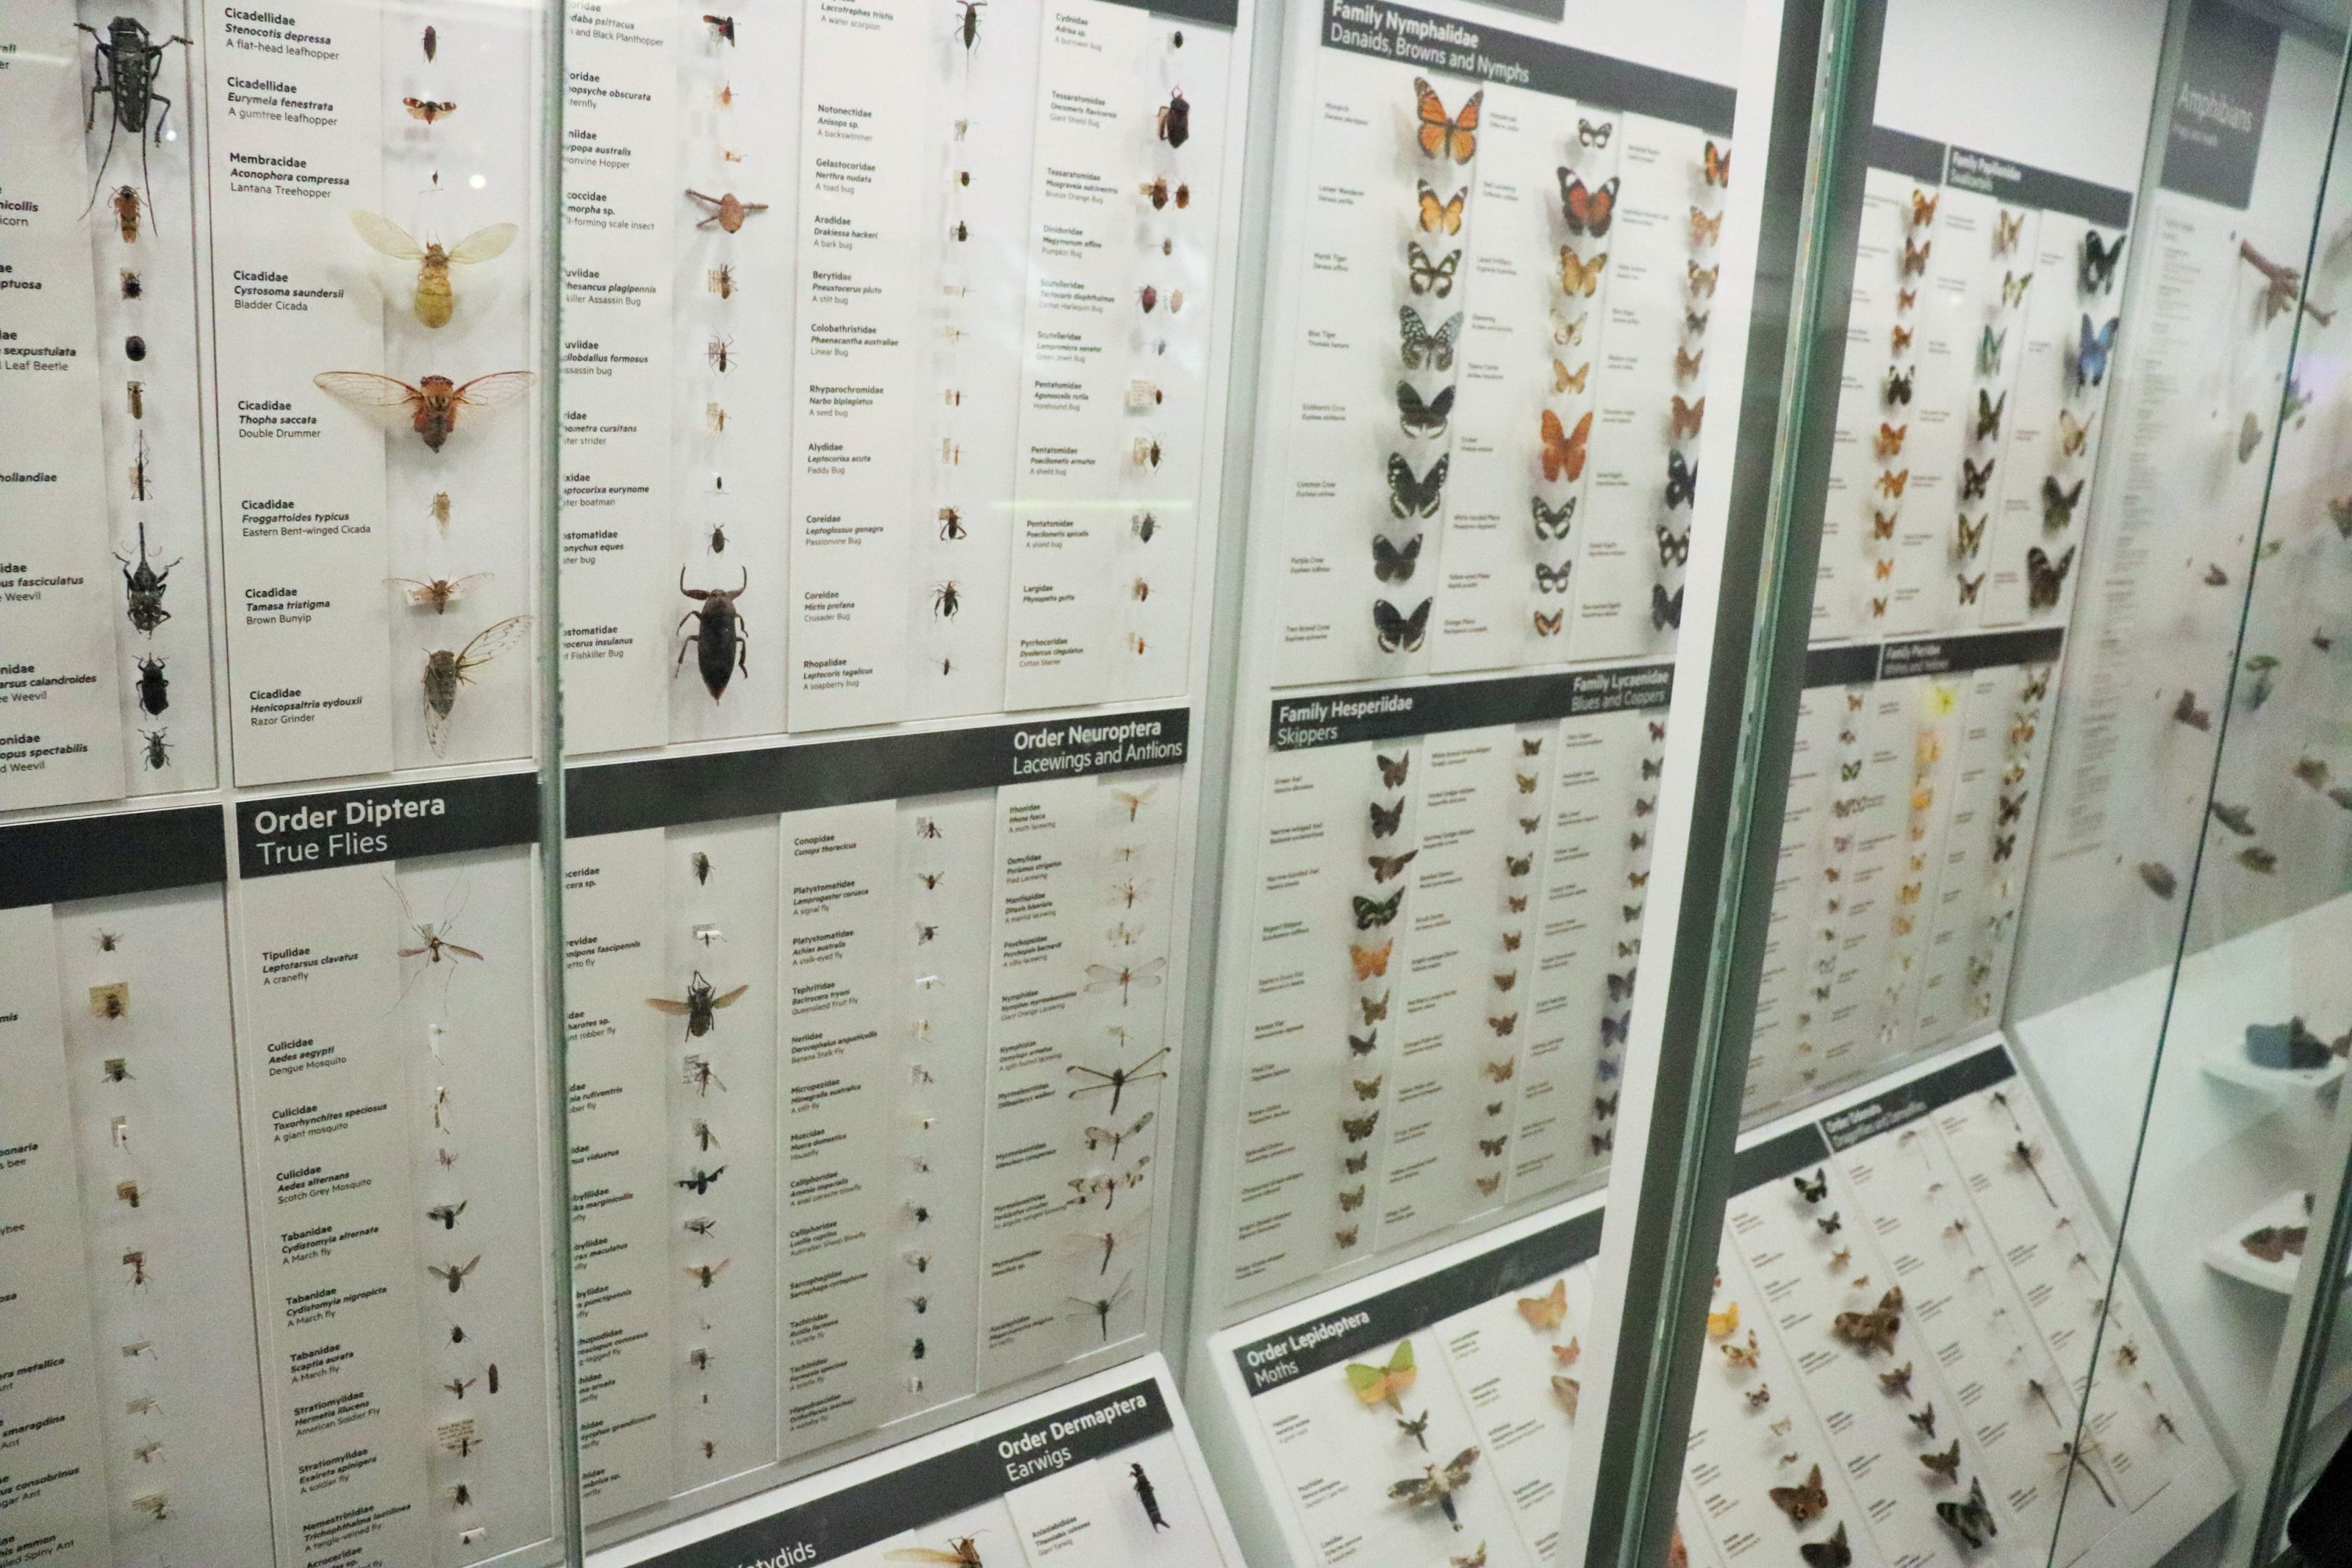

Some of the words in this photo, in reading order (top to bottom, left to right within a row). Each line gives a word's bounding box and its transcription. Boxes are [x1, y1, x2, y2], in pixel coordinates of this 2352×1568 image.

[225, 8, 295, 25] Cicadellidae
[1332, 1, 1382, 28] Family
[1387, 11, 1479, 48] Nymphalidae
[226, 24, 281, 38] Stenocotis
[285, 31, 331, 45] depressa
[593, 30, 614, 40] Black
[616, 33, 663, 46] Planthopper
[226, 39, 234, 48] A
[237, 40, 282, 54] flat-head
[287, 46, 339, 60] leafhopper
[1331, 23, 1393, 56] Danaids,
[1396, 37, 1446, 64] Browns
[1450, 52, 1474, 70] and
[1477, 55, 1530, 83] Nymphs
[227, 77, 297, 93] Cicadellidae
[228, 92, 277, 106] Eurymela
[281, 98, 333, 111] fenestrata
[610, 90, 651, 101] obscurata
[240, 110, 282, 121] gumtree
[285, 113, 338, 126] leafhopper
[818, 105, 872, 118] Notonectidae
[595, 147, 631, 156] australis
[230, 152, 306, 168] Membracidae
[600, 159, 629, 169] Hopper
[231, 168, 293, 181] Aconophora
[296, 171, 349, 186] compressa
[232, 183, 271, 194] Lantana
[275, 186, 331, 198] Treehopper
[609, 219, 629, 229] scale
[814, 216, 851, 225] Aradidae
[234, 271, 288, 282] Cicadidae
[813, 271, 852, 282] Berytidae
[234, 286, 290, 298] Cystosoma
[293, 289, 344, 298] saundersii
[608, 285, 656, 294] plagipennis
[234, 300, 272, 309] Bladder
[276, 302, 308, 311] Cicada
[588, 295, 623, 304] Assassin
[626, 298, 641, 306] Bug
[4, 347, 76, 356] sexpustulata
[5, 362, 30, 370] Leaf
[33, 362, 68, 371] Beetle
[597, 367, 612, 375] bug
[238, 401, 292, 410] Cicadidae
[240, 415, 277, 425] Thopha
[809, 443, 844, 452] Alydidae
[242, 500, 295, 510] Cicadidae
[242, 513, 311, 524] Froggattoides
[315, 513, 349, 523] typicus
[807, 515, 841, 523] Coreidae
[242, 528, 278, 537] Eastern
[281, 526, 338, 536] Bent-winged
[341, 525, 370, 534] Cicada
[17, 577, 83, 587] fasciculatus
[7, 592, 41, 601] Weevil
[245, 588, 298, 599] Cicadidae
[247, 603, 283, 612] Tamasa
[287, 600, 330, 611] tristigma
[247, 616, 276, 624] Brown
[279, 614, 311, 624] Bunyip
[571, 650, 605, 660] Fishkiller
[804, 658, 846, 669] Rhopalidae
[30, 674, 97, 686] calandroides
[1574, 674, 1609, 692] Family
[12, 692, 47, 701] Weevil
[250, 689, 301, 700] Cicadidae
[251, 701, 320, 713] Henicopsaltria
[323, 697, 362, 708] eydouxii
[1280, 702, 1328, 723] Family
[1331, 695, 1413, 719] Hesperiidae
[1572, 695, 1600, 711] Blues
[1603, 693, 1622, 708] and
[251, 717, 277, 726] Razor
[281, 714, 315, 724] Grinder
[1014, 728, 1065, 750] Order
[1069, 721, 1161, 744] Neuroptera
[1278, 727, 1337, 746] Skippers
[30, 745, 88, 756] spectabilis
[1013, 751, 1091, 775] Lacewings
[1095, 746, 1122, 764] and
[1125, 741, 1183, 761] Antlions
[10, 762, 45, 772] Weevil
[255, 807, 337, 834] Order
[346, 799, 445, 826] Diptera
[794, 835, 835, 846] Conopidae
[256, 842, 319, 865] True
[330, 833, 388, 857] Flies
[793, 881, 854, 894] Platystomatidae
[793, 930, 854, 945] Platystomatidae
[262, 947, 311, 961] Tipulidae
[263, 958, 318, 973] Leptotarsus
[321, 953, 358, 965] clavatus
[273, 972, 309, 984] cranefly
[793, 982, 835, 995] Tephritidae
[268, 1038, 314, 1052] Culicidae
[269, 1053, 301, 1064] Aedes
[300, 1046, 335, 1058] aegypti
[269, 1065, 303, 1076] Dengue
[307, 1057, 346, 1070] Mosquito
[272, 1105, 317, 1119] Culicidae
[274, 1112, 343, 1131] Toxorhynchites
[346, 1103, 388, 1118] speciosus
[284, 1131, 306, 1143] giant
[309, 1122, 348, 1135] mosquito
[277, 1166, 322, 1181] Culicidae
[277, 1180, 305, 1192] Aedes
[308, 1172, 349, 1185] alternans
[277, 1192, 307, 1204] Scotch
[310, 1187, 330, 1197] Grey
[332, 1179, 372, 1193] Mosquito
[282, 1225, 332, 1242] Tabanidae
[282, 1236, 336, 1254] Cydistomyia
[292, 1251, 318, 1262] March
[286, 1288, 337, 1304] Tabanidae
[287, 1299, 340, 1316] Cydistomyia
[1247, 1341, 1288, 1367] Order
[1289, 1311, 1370, 1351] Lepidoptera
[290, 1344, 340, 1363] Tabanidae
[17, 1357, 65, 1376] metallica
[1254, 1360, 1299, 1387] Moths
[3, 1416, 65, 1437] smaragdina
[999, 1430, 1048, 1459] Order
[1050, 1395, 1147, 1441] Dermaptera
[1006, 1447, 1071, 1482] Earwigs
[16, 1467, 80, 1491] consobrinus
[23, 1490, 41, 1500] Ant
